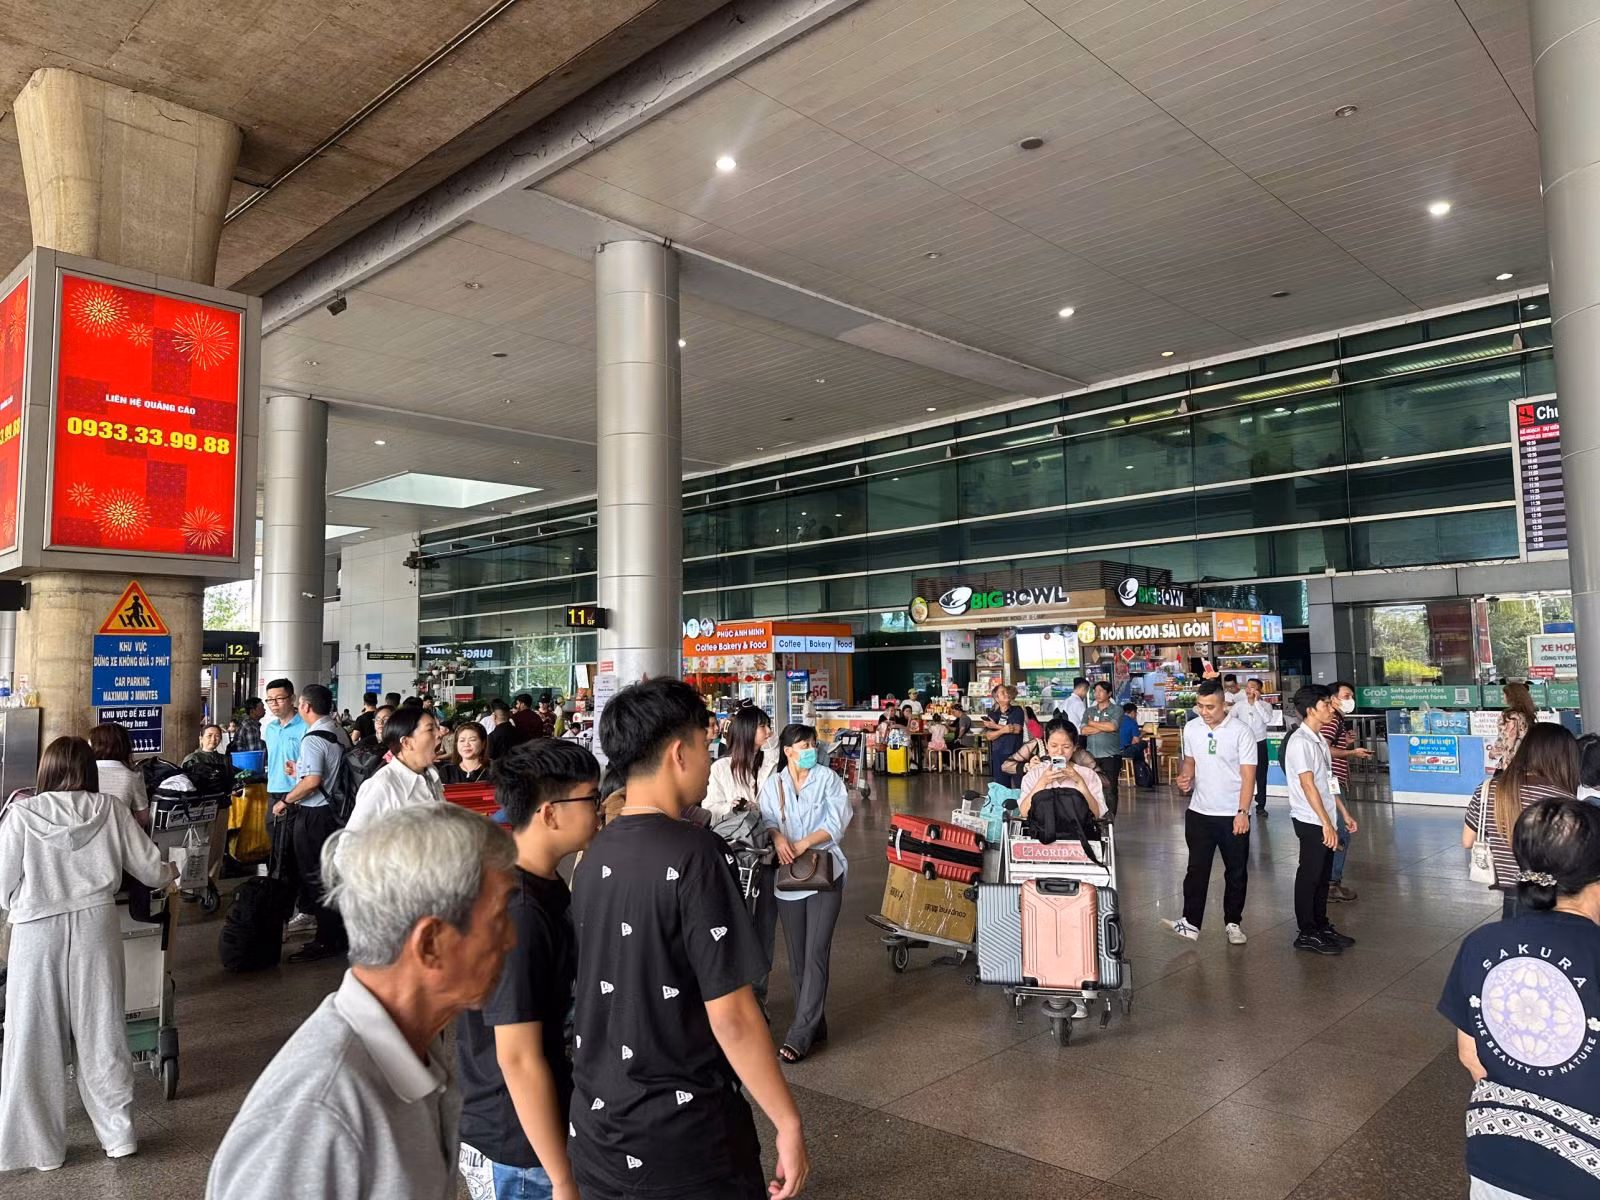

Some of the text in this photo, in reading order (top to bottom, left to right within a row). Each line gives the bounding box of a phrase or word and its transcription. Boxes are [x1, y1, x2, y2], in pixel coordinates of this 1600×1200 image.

[106, 394, 128, 404] LIÊN
[130, 397, 142, 408] HỆ
[144, 400, 176, 412] QUẢNG
[67, 416, 230, 455] 0933.33.99.88
[568, 609, 585, 624] 11
[717, 629, 734, 638] PHÚC
[1100, 622, 1124, 640] MÓN
[1182, 618, 1210, 638] GÒN
[119, 640, 147, 654] KHU VỰC
[228, 645, 243, 655] 12
[719, 642, 741, 651] Bakery
[750, 640, 767, 648] Food
[810, 640, 832, 649] Bakery
[110, 656, 118, 666] XE
[119, 655, 137, 666] KHÔNG
[151, 656, 154, 666] 3
[155, 654, 169, 666] PHÚT
[115, 676, 150, 687] CAR PARKING
[103, 690, 158, 702] MAXIMUM 3 MINUTES
[1363, 688, 1387, 697] Grab
[1482, 944, 1587, 988] SAKURA
[1474, 1014, 1488, 1037] THE
[1486, 1040, 1531, 1074] BEAUTY
[1560, 1037, 1596, 1074] NATURE
